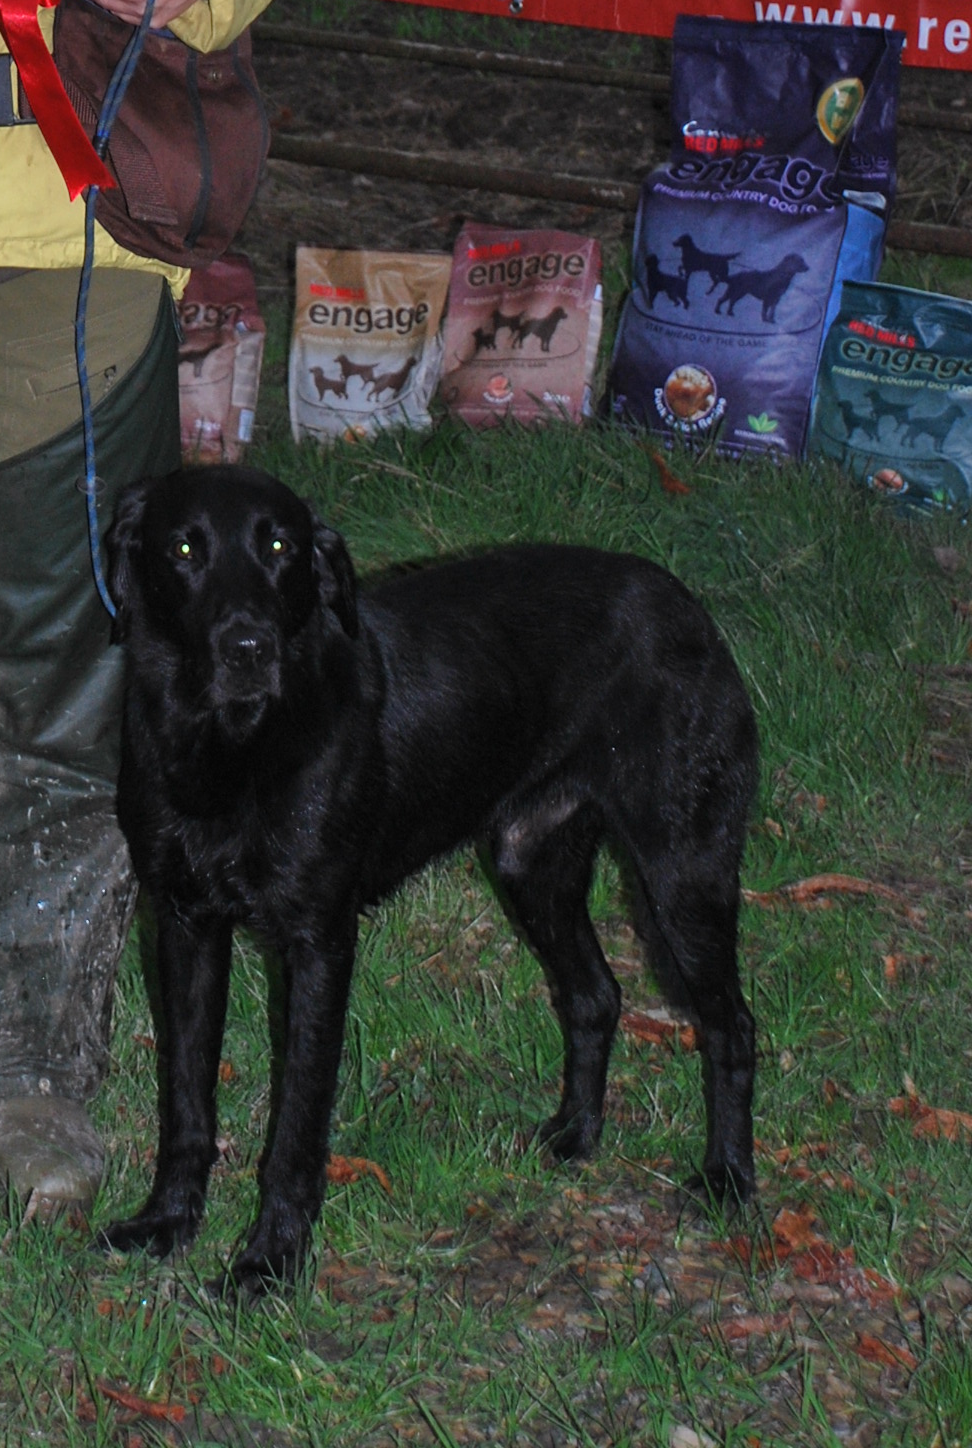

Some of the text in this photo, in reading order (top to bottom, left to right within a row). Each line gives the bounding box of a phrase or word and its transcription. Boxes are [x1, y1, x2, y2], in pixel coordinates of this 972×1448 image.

[684, 135, 718, 152] RED
[768, 195, 797, 213] DOG
[468, 252, 585, 287] engage
[309, 302, 429, 334] engage
[699, 333, 712, 344] OF
[715, 336, 733, 346] THE
[738, 337, 768, 348] GAME
[927, 381, 949, 391] DOG
[654, 388, 667, 418] Duck
